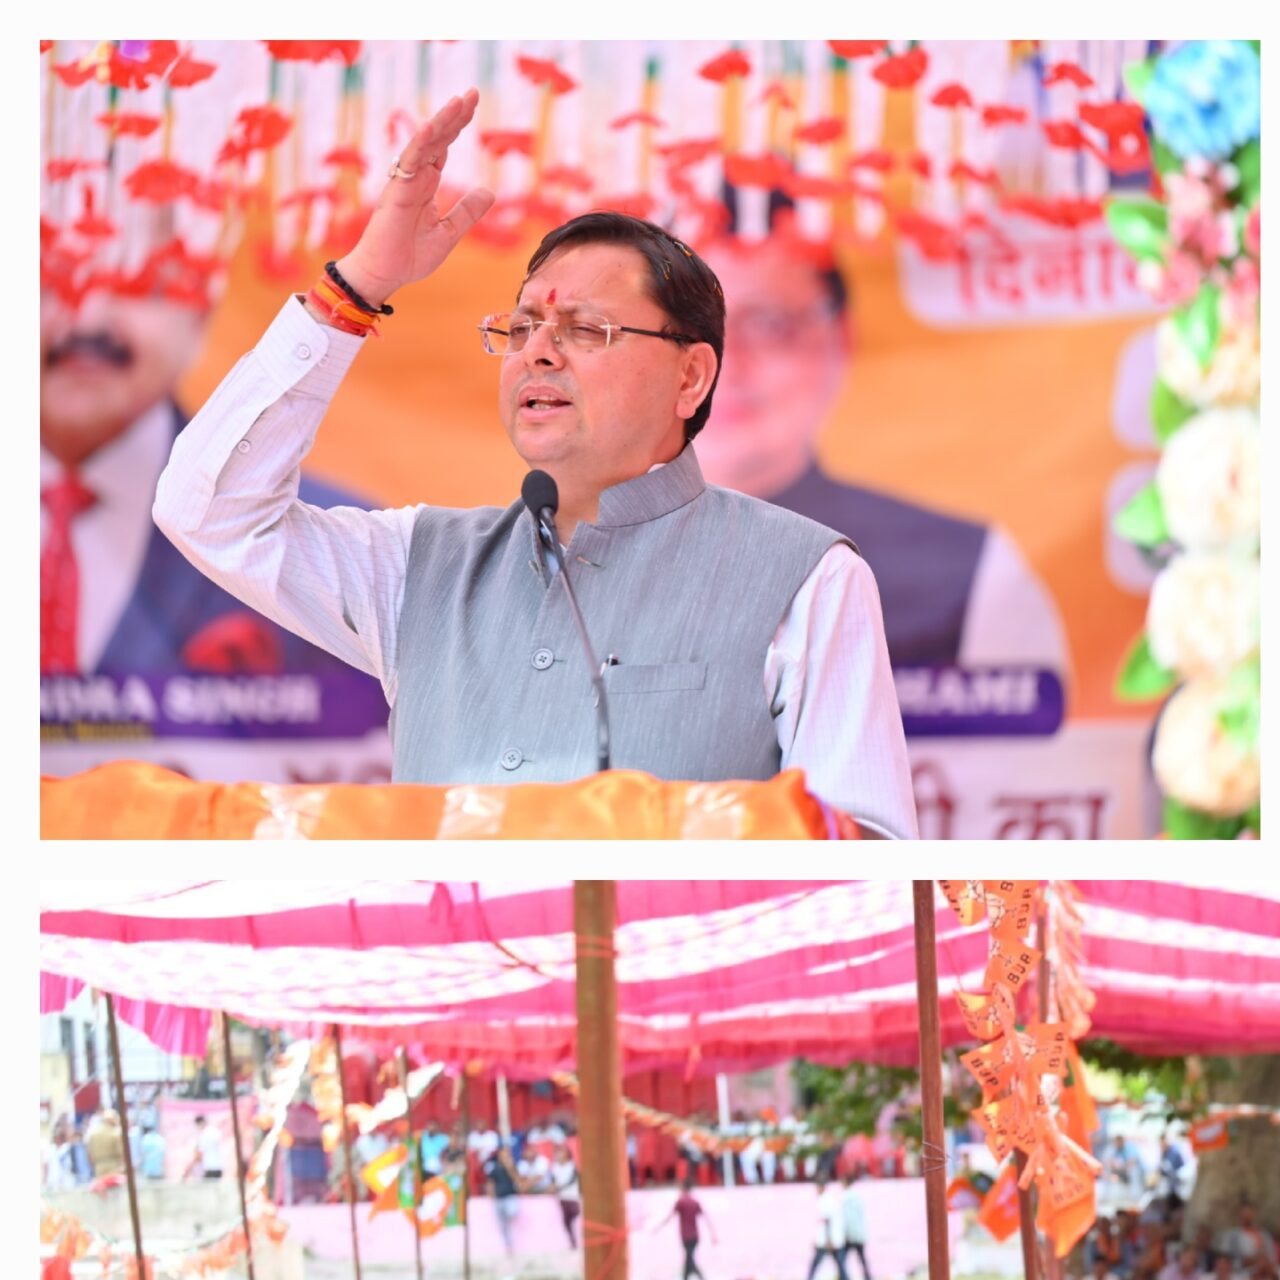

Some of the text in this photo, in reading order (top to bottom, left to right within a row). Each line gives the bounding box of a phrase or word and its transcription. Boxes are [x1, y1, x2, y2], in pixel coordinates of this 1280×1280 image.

[1016, 888, 1032, 930] BJP
[1007, 953, 1031, 985] BJP
[1049, 1031, 1065, 1069] BJP
[970, 1058, 999, 1087] BJP
